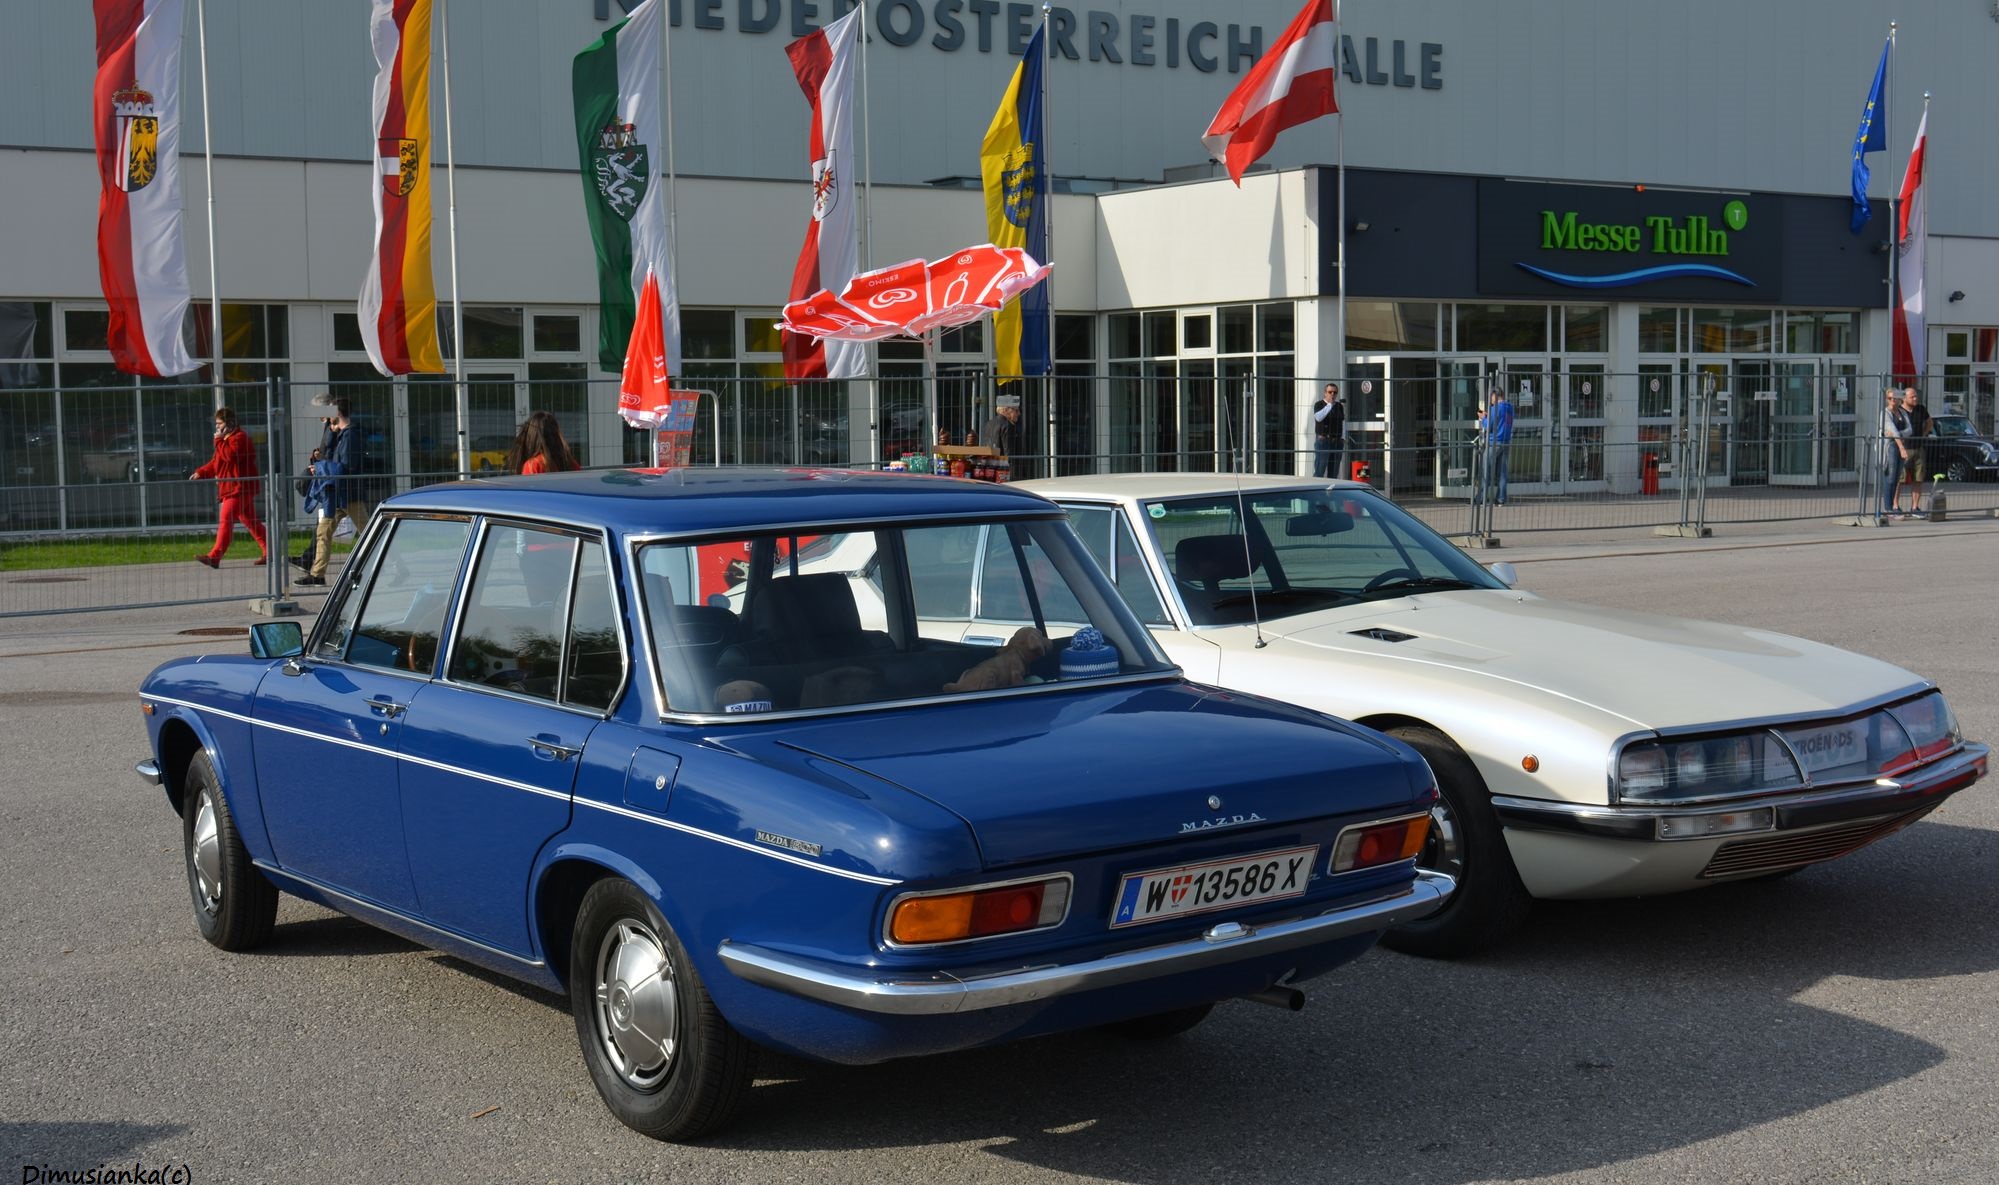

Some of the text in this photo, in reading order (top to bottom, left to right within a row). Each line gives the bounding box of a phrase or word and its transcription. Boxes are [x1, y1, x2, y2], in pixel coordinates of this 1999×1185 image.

[1541, 211, 1728, 255] Messe Tulln
[869, 274, 898, 287] ESKIMO
[1181, 812, 1262, 832] MAZDA
[757, 832, 788, 847] MAZDA
[1121, 904, 1130, 917] A
[1146, 879, 1171, 913] W
